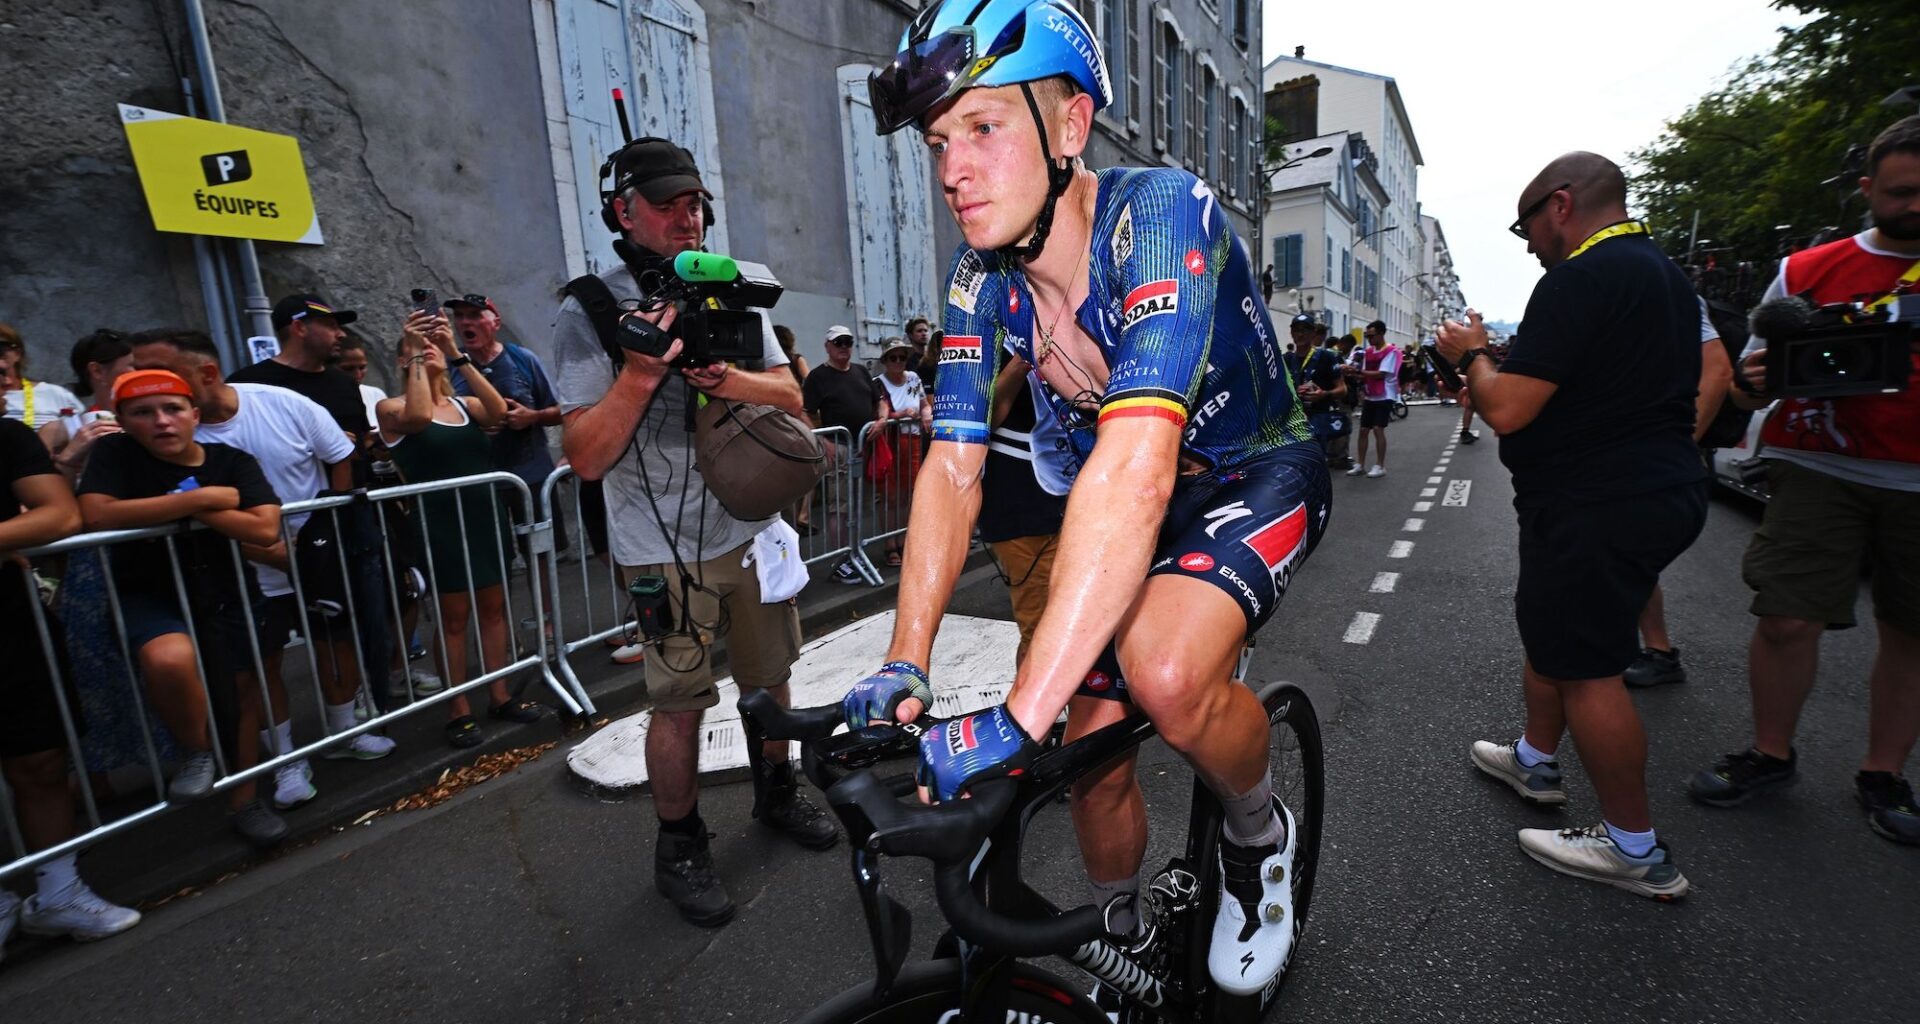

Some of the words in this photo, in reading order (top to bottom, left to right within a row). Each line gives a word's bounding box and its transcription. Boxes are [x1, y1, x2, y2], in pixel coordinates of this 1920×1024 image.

[216, 155, 235, 182] P
[193, 189, 280, 219] ÉQUIPES
[626, 324, 648, 337] SONY
